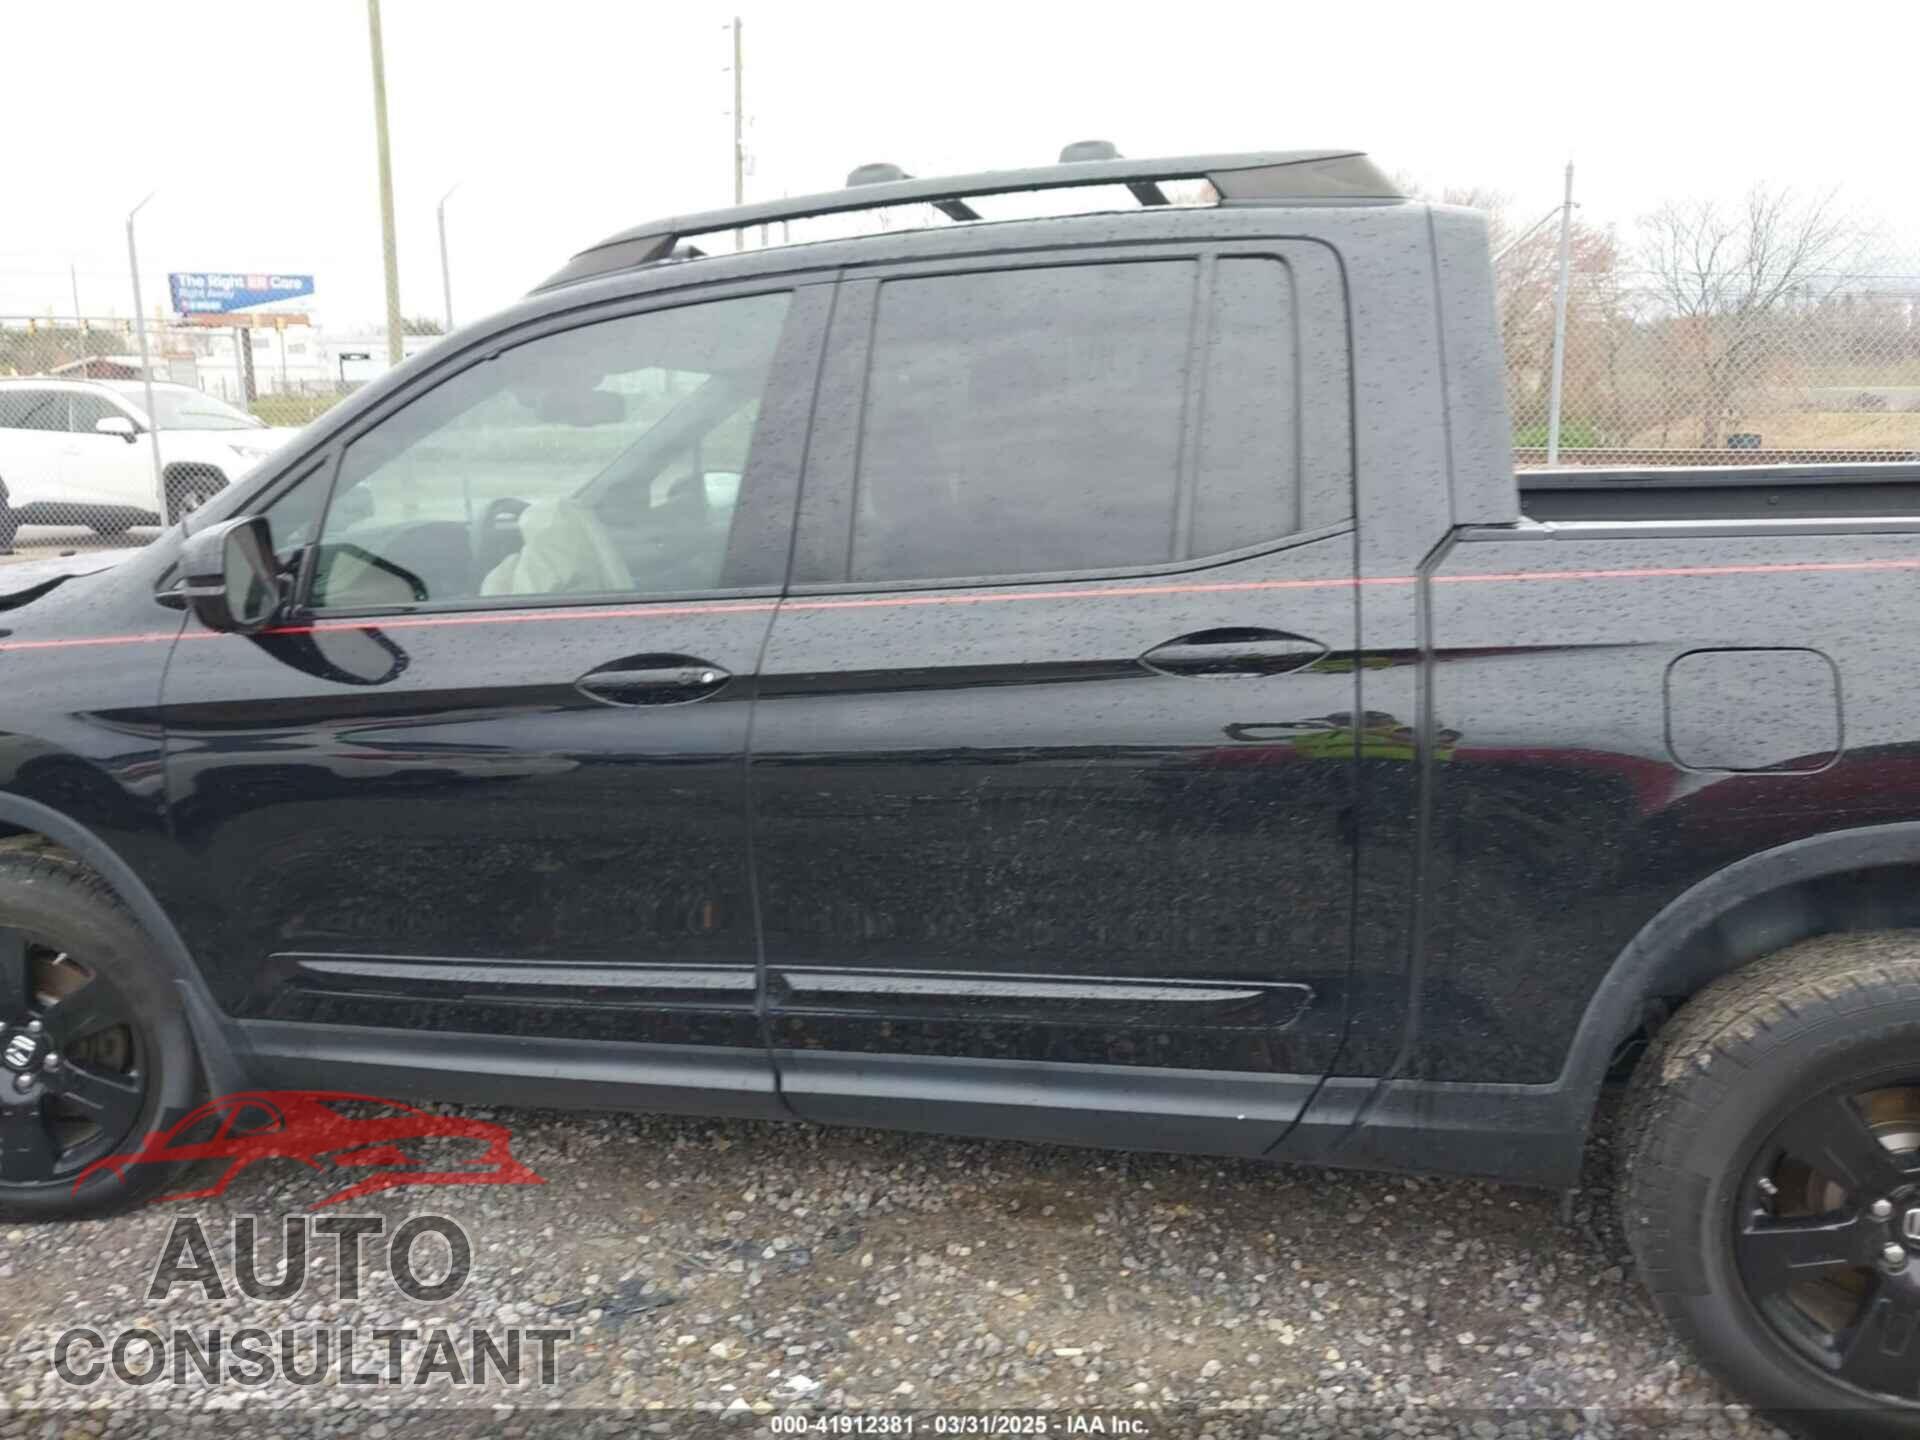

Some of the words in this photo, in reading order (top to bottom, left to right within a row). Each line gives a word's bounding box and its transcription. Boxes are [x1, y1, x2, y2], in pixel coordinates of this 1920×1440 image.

[178, 274, 206, 288] The
[207, 274, 245, 291] Right
[270, 276, 304, 290] Care
